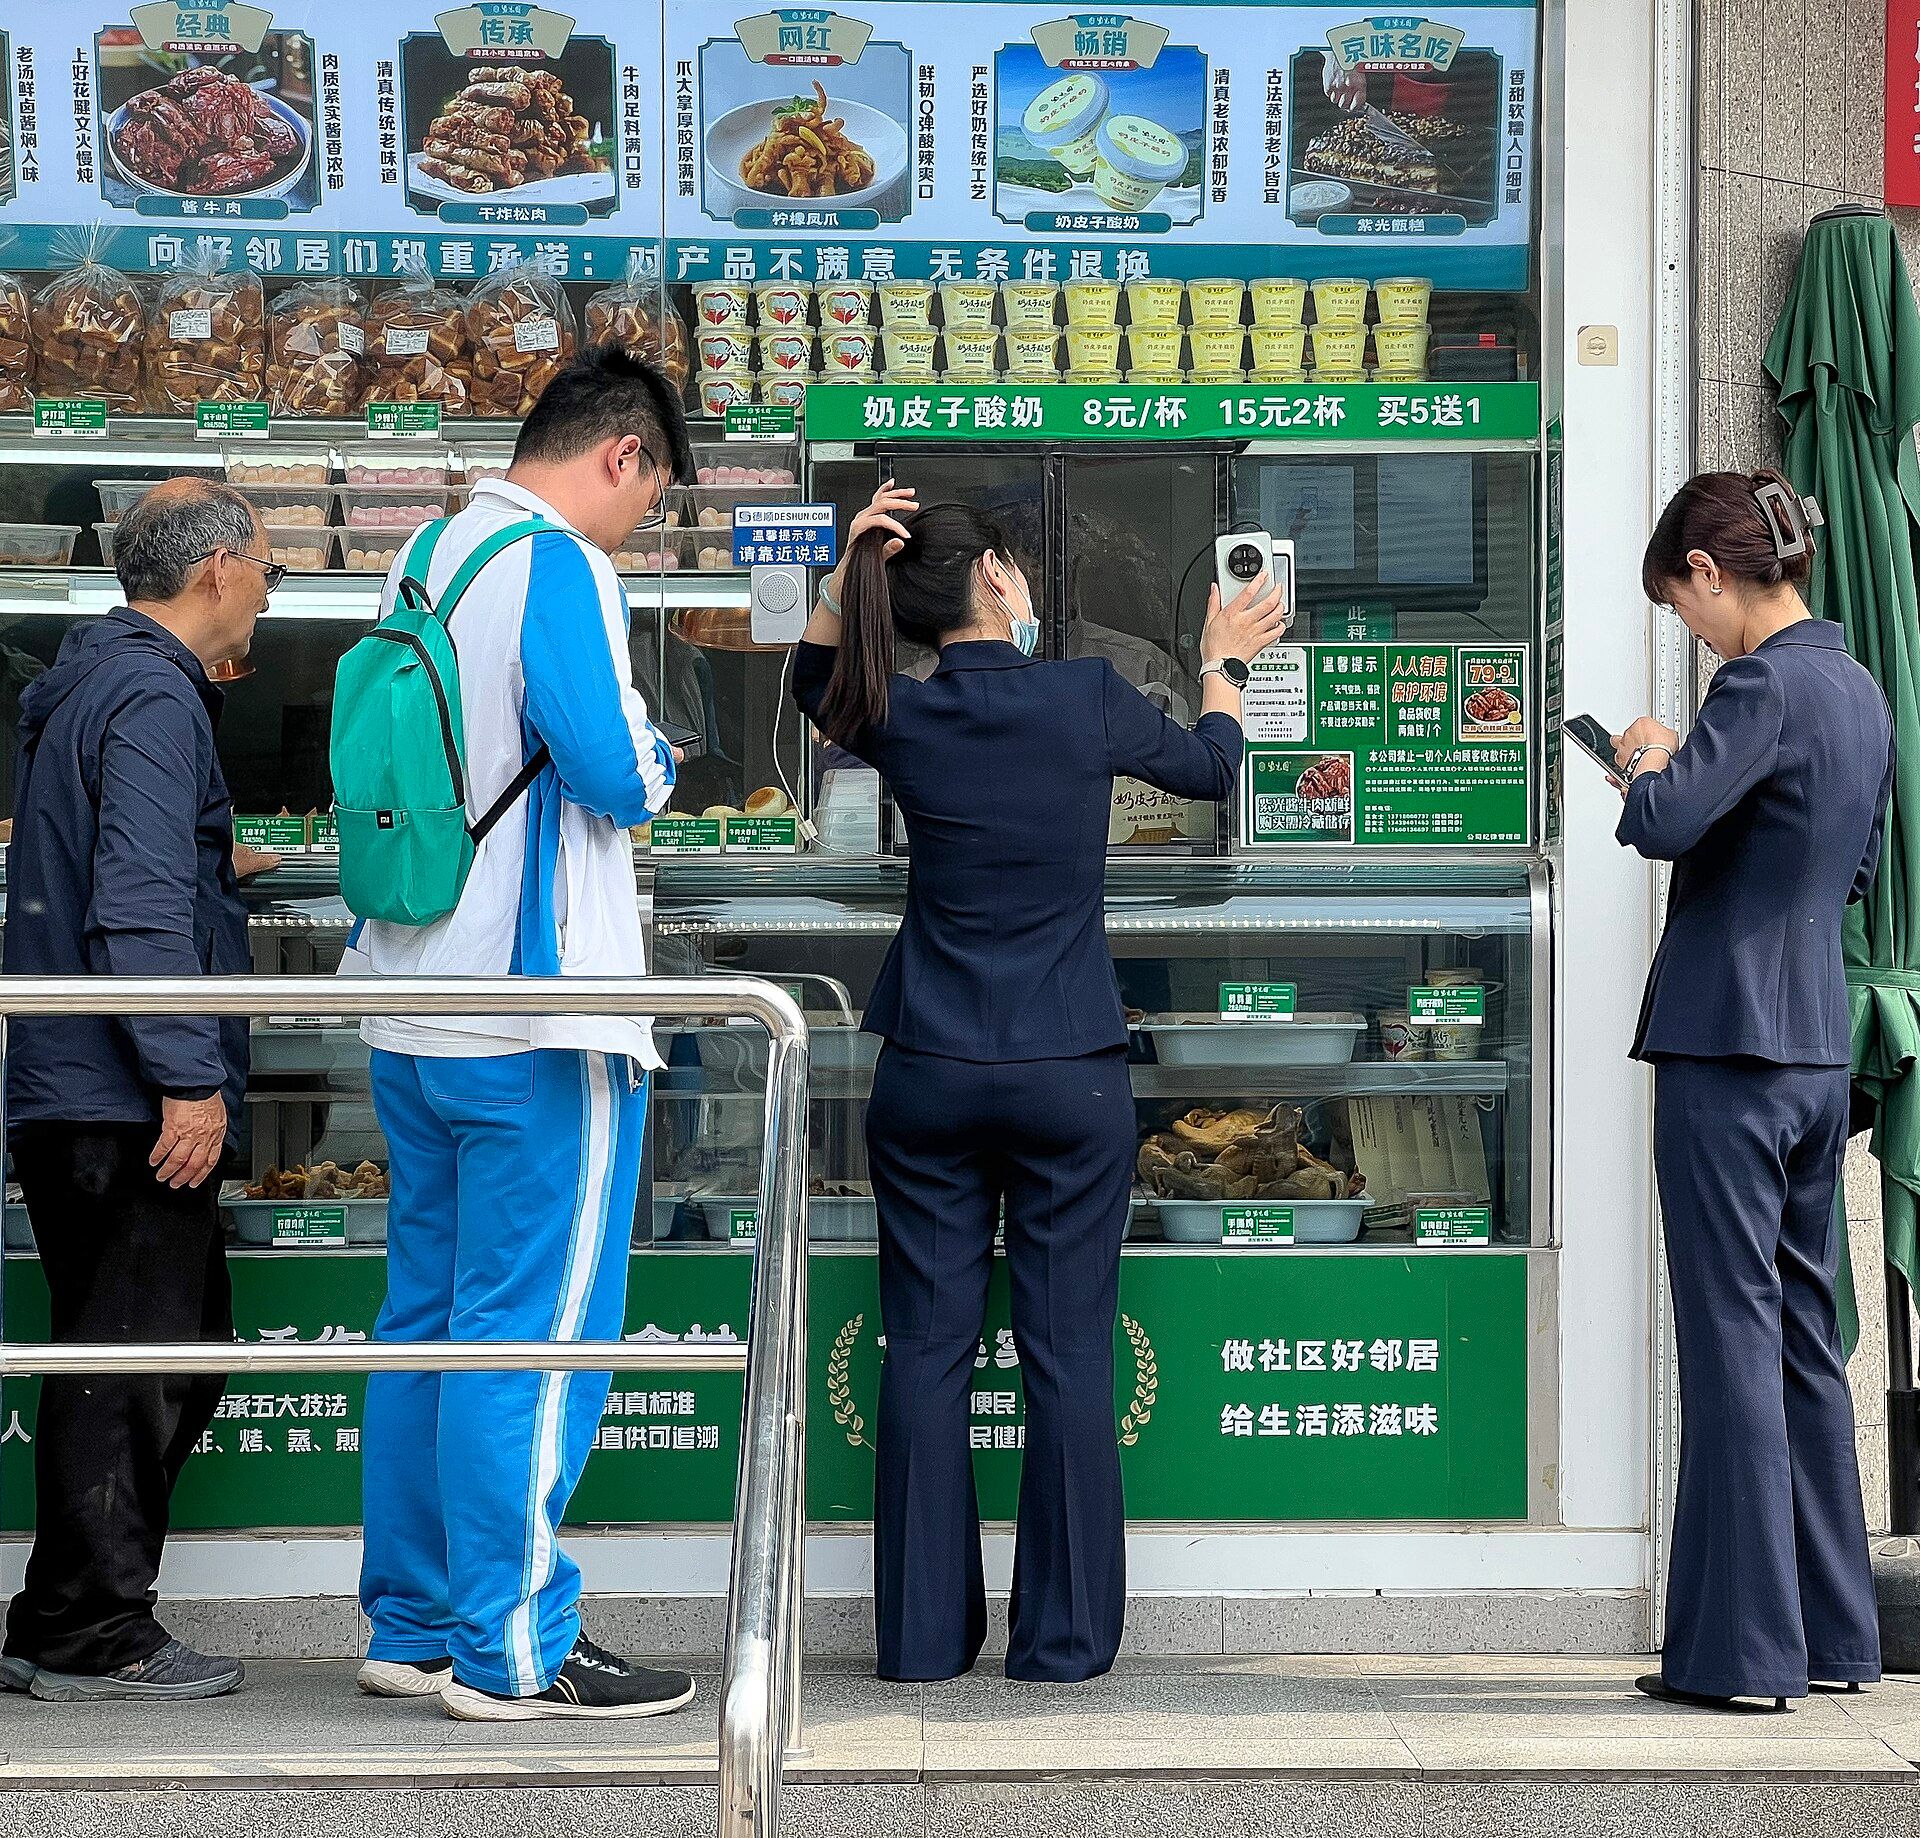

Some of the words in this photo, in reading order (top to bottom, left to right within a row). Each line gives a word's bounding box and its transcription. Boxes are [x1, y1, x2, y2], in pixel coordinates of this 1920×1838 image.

[175, 13, 231, 40] 经典
[479, 19, 534, 45] 传承
[779, 26, 832, 51] 网红
[1074, 30, 1128, 56] 畅销
[1341, 33, 1452, 64] 京味名吃
[72, 47, 94, 183] 上好花腱文火慢炖
[322, 53, 344, 190] 肉质紧实酱香浓郁
[376, 60, 398, 185] 清真传统老味道
[622, 65, 641, 189] 牛肉足料满口香
[676, 60, 694, 197] 爪大掌厚胶原满满
[918, 64, 935, 199] 鲜韧Q弹酸辣爽口
[970, 66, 988, 200] 严选好奶传统工艺
[1211, 69, 1230, 203] 清真老味浓郁奶香
[1263, 68, 1283, 204] 古法蒸制老少皆宜
[181, 200, 242, 216] 酱牛肉
[478, 206, 547, 222] 干炸松肉
[772, 211, 839, 227] 柠檬凤爪
[1055, 215, 1140, 230] 奶皮子酸奶
[929, 247, 1150, 282] 无条件退换
[863, 396, 1043, 429] 奶皮子酸奶
[1082, 396, 1187, 429] 8元/杯
[1218, 395, 1346, 428] 15元2杯
[1377, 394, 1482, 427] 买5送1
[752, 529, 817, 542] 温馨提示您
[739, 545, 830, 563] 请靠近说话
[1322, 656, 1377, 673] 温馨提示
[1390, 655, 1448, 677] 人人有责
[1469, 664, 1511, 684] 79.9
[1391, 681, 1448, 703] 保护环境
[1398, 706, 1441, 721] 食品袋收费
[1113, 791, 1193, 810] 奶皮子酸
[1259, 796, 1350, 813] 紫光酱牛肉新鲜
[1259, 814, 1350, 830] 购买需冷藏储存
[1220, 1339, 1439, 1372] 做社区好邻居
[1220, 1403, 1439, 1437] 给生活添滋味
